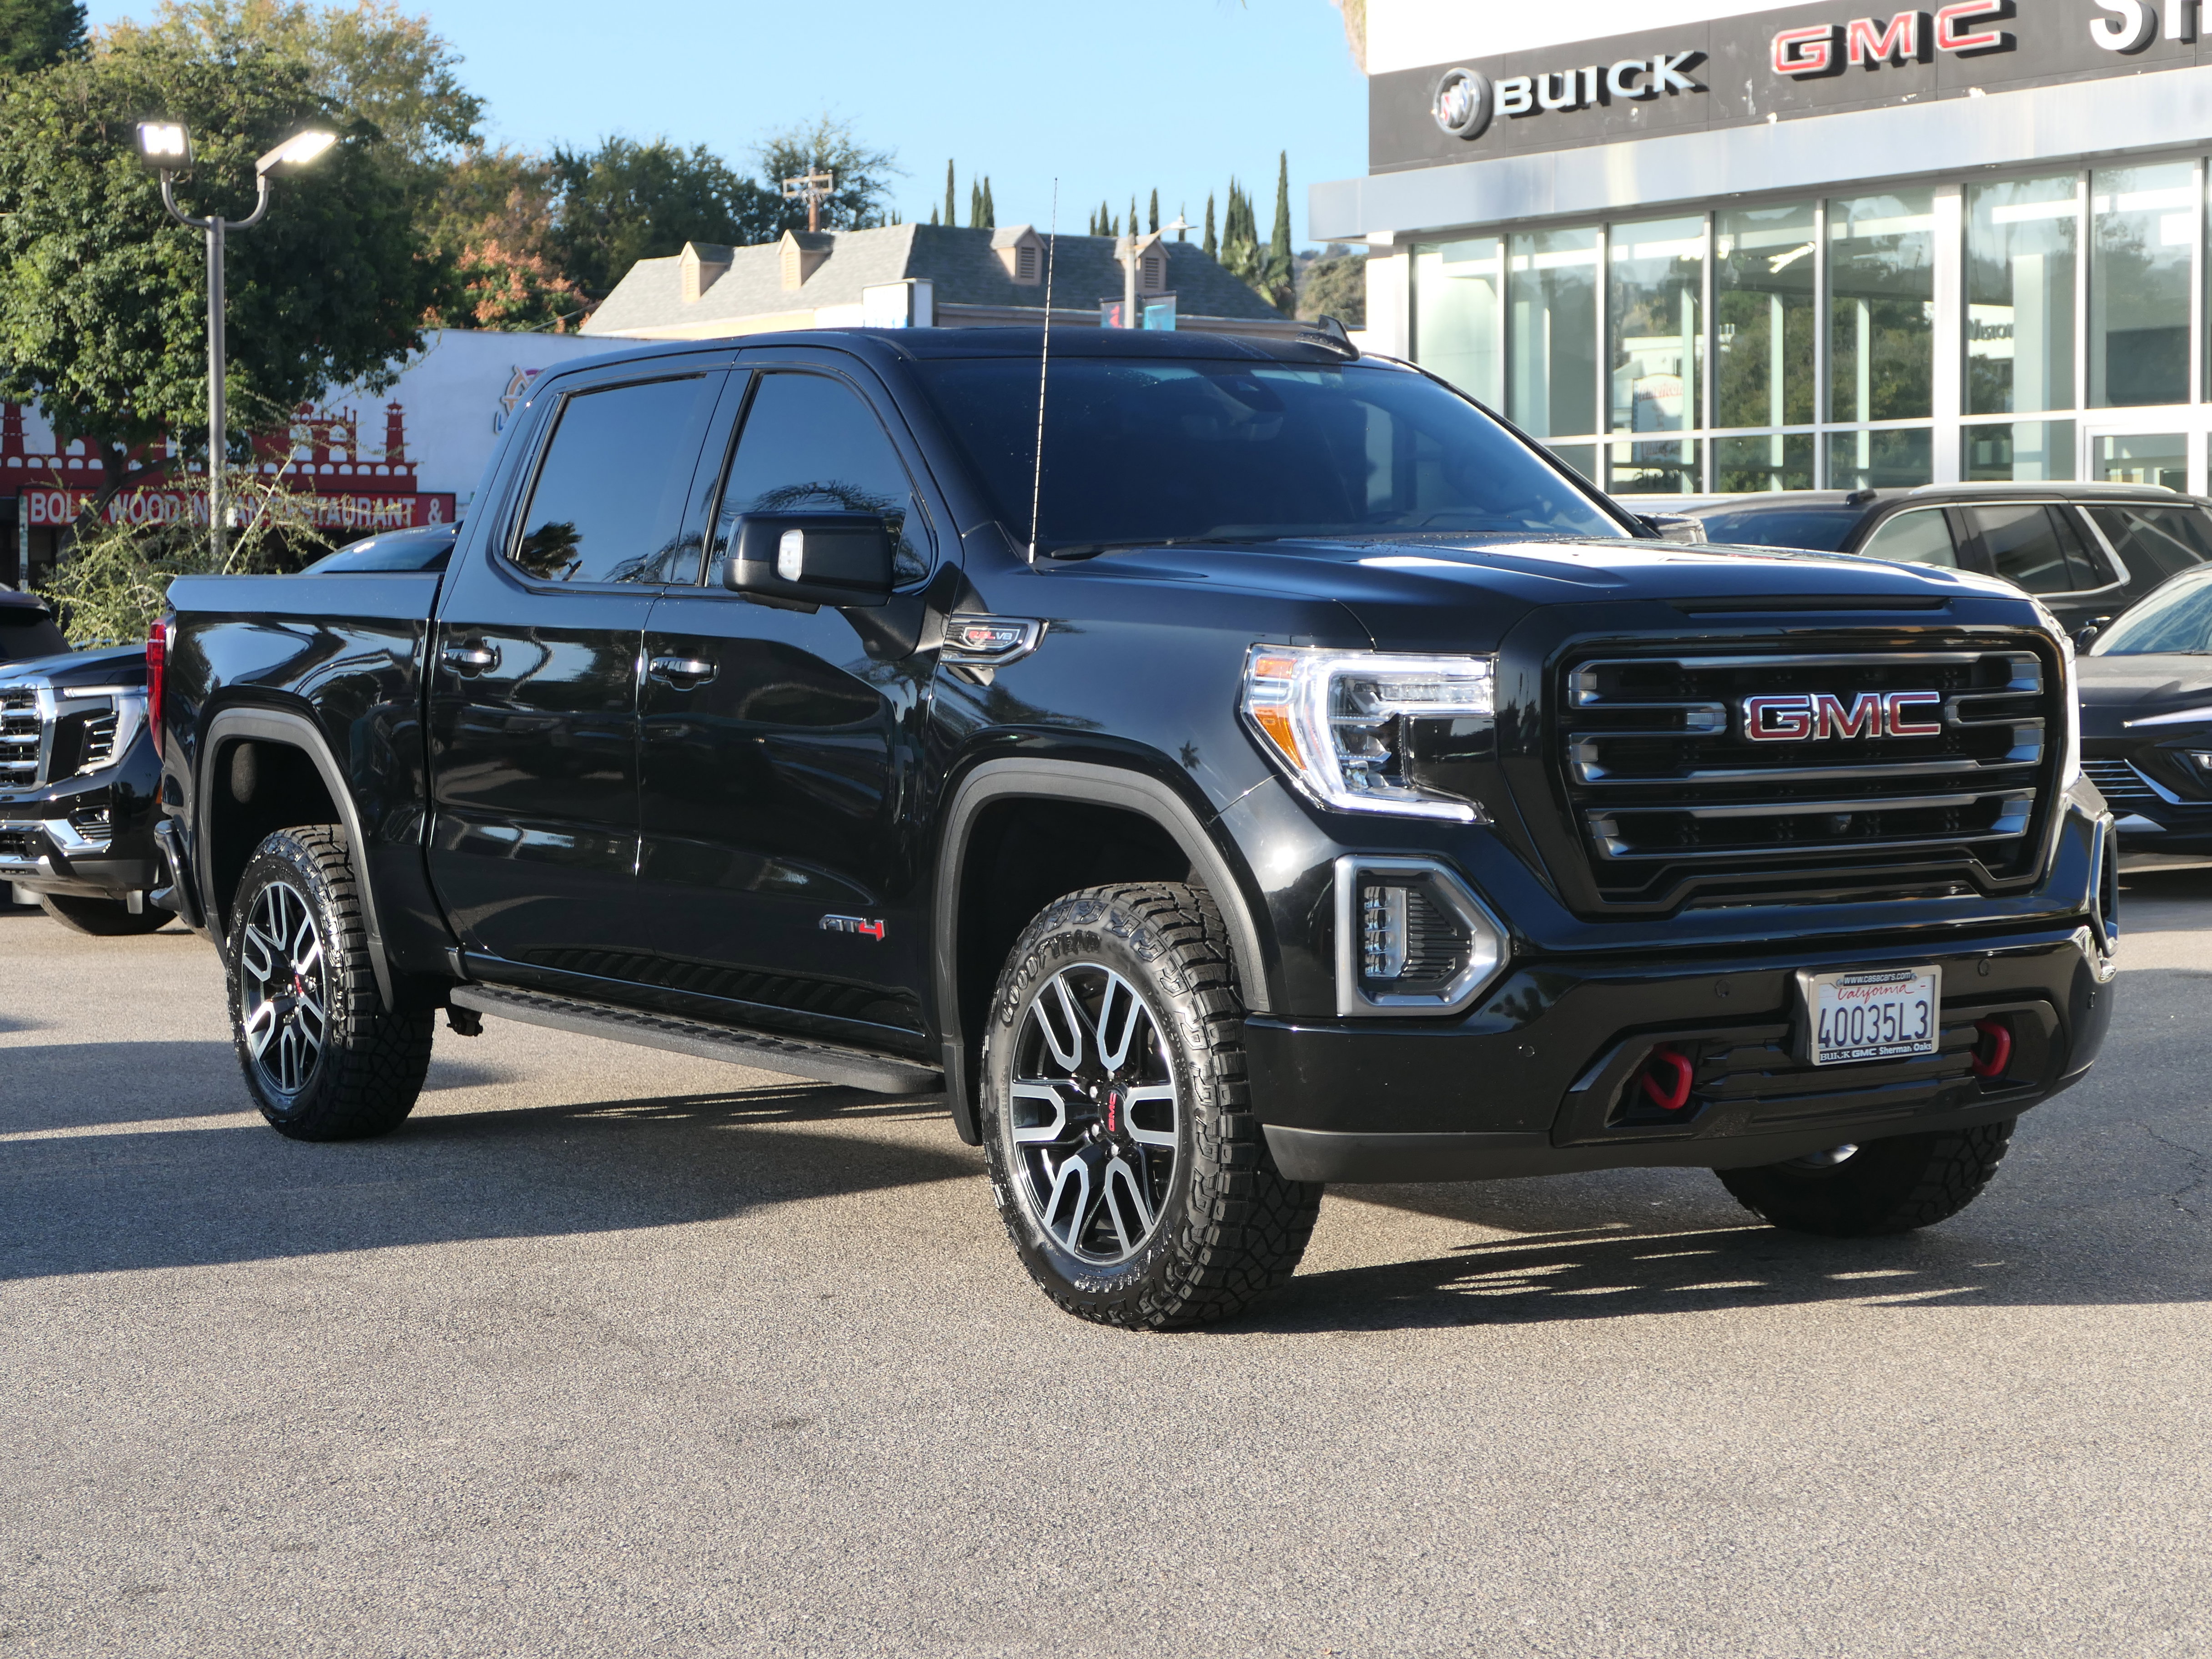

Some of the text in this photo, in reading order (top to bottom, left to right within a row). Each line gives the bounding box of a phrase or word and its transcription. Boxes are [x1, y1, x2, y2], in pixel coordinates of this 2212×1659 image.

[1771, 0, 2001, 75] GMC
[1494, 50, 1695, 116] BUICK
[996, 631, 1013, 640] V8
[1743, 691, 1941, 741] GMC
[819, 914, 885, 941] AT4
[1838, 984, 1915, 1004] California
[1844, 972, 1911, 984] www.casacars.com
[1819, 1000, 1928, 1048] 40035L3
[1852, 1048, 1877, 1057] GMC
[1879, 1045, 1912, 1055] Sherman
[1913, 1042, 1932, 1051] Oaks
[1109, 1092, 1117, 1132] GMC
